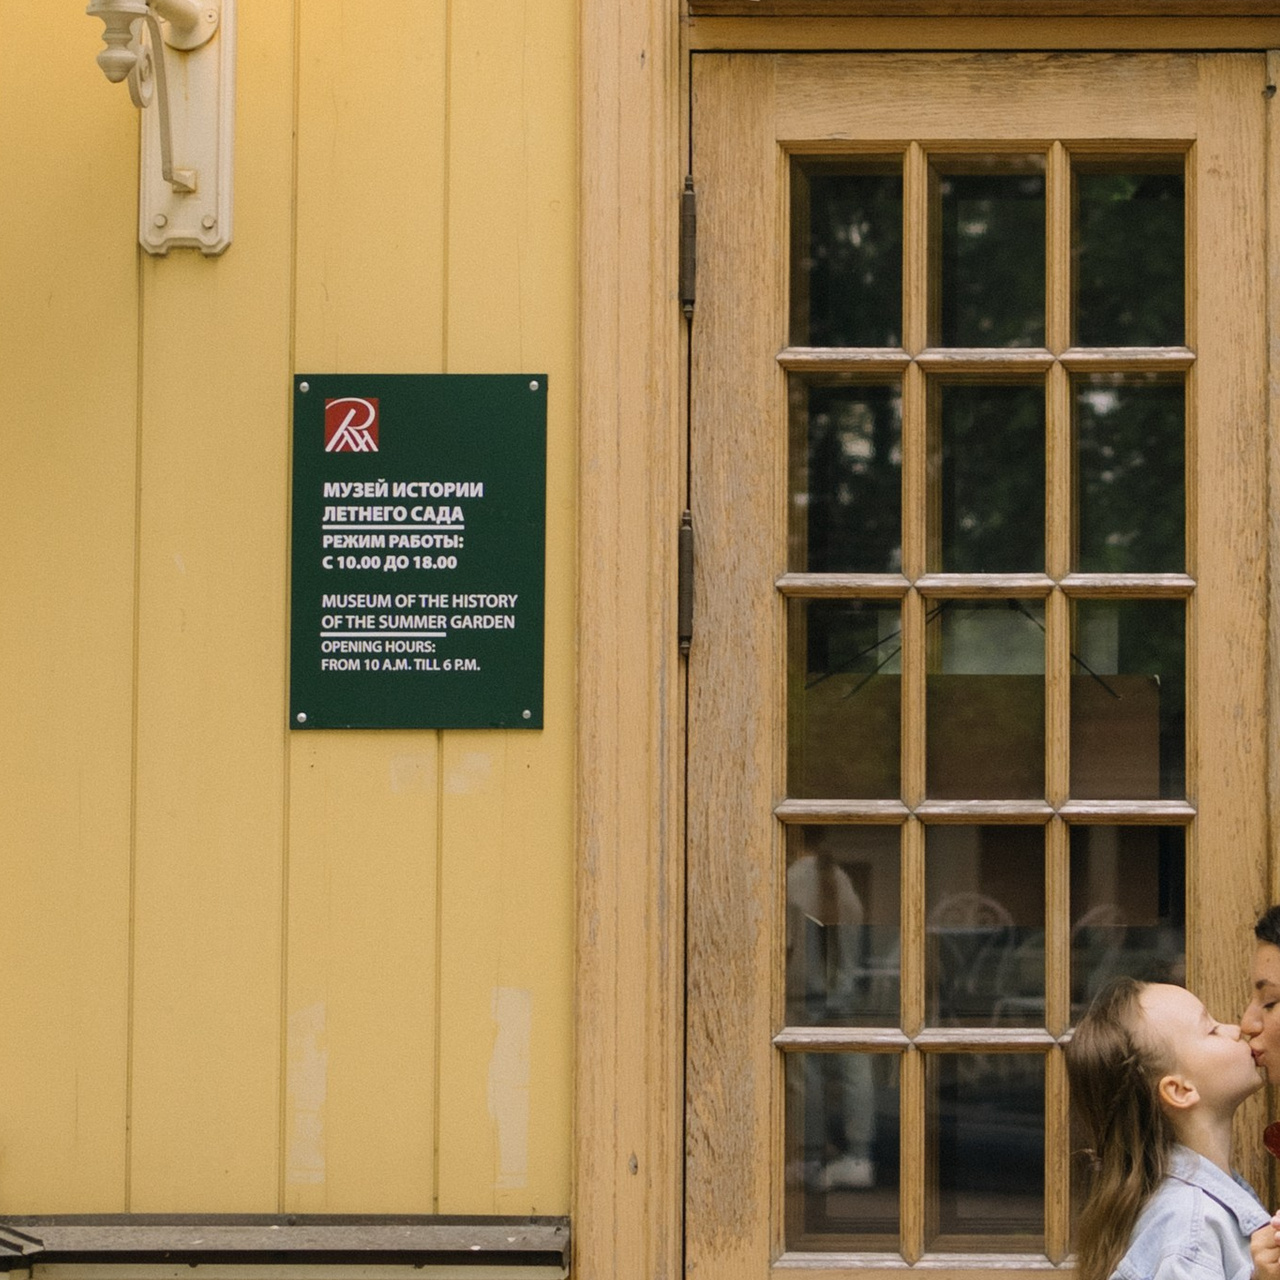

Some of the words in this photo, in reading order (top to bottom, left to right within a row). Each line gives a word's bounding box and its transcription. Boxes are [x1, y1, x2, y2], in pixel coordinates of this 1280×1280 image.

[323, 478, 389, 498] МУЗЕЙ
[392, 481, 484, 498] ИСТОРИИ
[321, 505, 408, 522] ЛЕТНЕГО
[410, 505, 465, 525] САДА
[322, 534, 386, 549] РЕЖИМ
[388, 534, 465, 549] РАБОТЫ:
[322, 555, 334, 570] С
[336, 555, 382, 570] 10.00
[383, 555, 410, 572] ДО
[412, 555, 458, 570] 18.00
[321, 593, 392, 609] MUSEUM
[394, 593, 417, 609] OF
[418, 593, 450, 609] THE
[451, 593, 519, 609] HISTORY
[321, 614, 344, 630] OF
[345, 614, 376, 630] THE
[378, 614, 448, 630] SUMMER
[449, 614, 516, 630] GARDEN
[320, 640, 383, 653] OPENING
[384, 640, 436, 653] HOURS:
[321, 658, 361, 671] FROM
[363, 658, 380, 671] 10
[381, 658, 412, 671] A.M.
[413, 658, 441, 671] TILL
[442, 658, 453, 671] 6
[454, 658, 481, 671] P.M.
